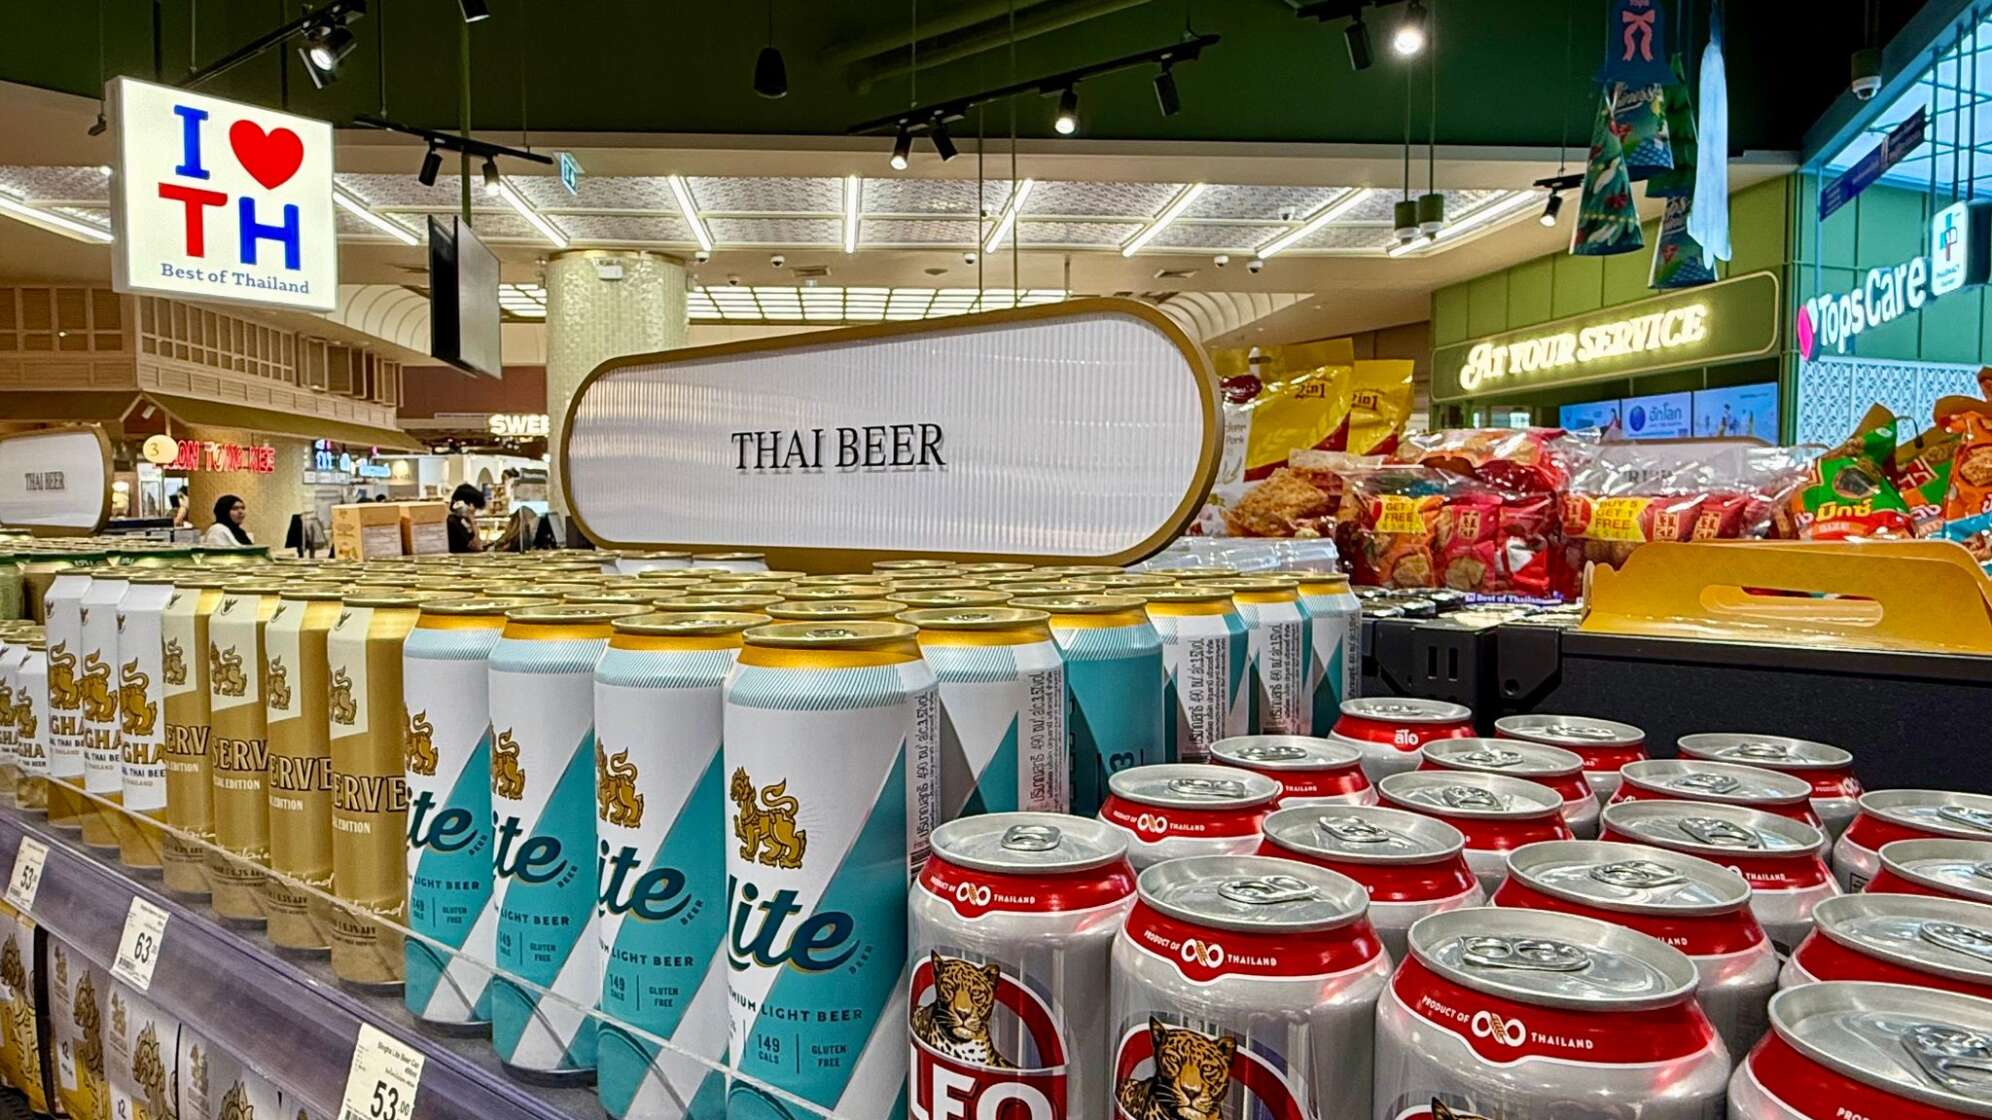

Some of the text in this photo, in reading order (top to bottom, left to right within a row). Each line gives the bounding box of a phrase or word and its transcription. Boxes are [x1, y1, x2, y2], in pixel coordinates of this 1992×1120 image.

[174, 104, 210, 180] I
[158, 182, 301, 271] TH
[161, 263, 310, 295] Best of Thailand
[1508, 332, 1577, 374] YOUR
[1576, 303, 1708, 362] SERVICE
[150, 442, 159, 457] 3
[731, 423, 947, 470] THAI BEER
[25, 471, 65, 491] THAI BEER
[1385, 512, 1413, 522] FREE
[1595, 518, 1632, 529] FREE
[130, 769, 145, 778] THAI
[224, 778, 261, 789] EDITION
[1285, 784, 1317, 793] THAILAND
[1169, 821, 1205, 832] THAILAND
[414, 876, 480, 891] LIGHT BEER
[1746, 872, 1786, 881] THAILAND
[993, 894, 1036, 905] THAILAND
[501, 909, 569, 926] LIGHT BEER
[134, 932, 153, 964] 63
[1144, 929, 1278, 967] PRODUCT OF THAILAND
[612, 949, 694, 967] LIGHT BEER
[609, 973, 625, 991] 149
[649, 986, 678, 996] GLUTEN
[655, 997, 673, 1007] FREE
[761, 1004, 811, 1022] LIGHT
[817, 1008, 863, 1022] BEER
[1421, 994, 1594, 1049] PRODUCT OF THAILAND
[757, 1033, 780, 1053] 149
[812, 1044, 846, 1055] GLUTEN
[759, 1053, 780, 1065] CALS
[818, 1057, 840, 1067] FREE
